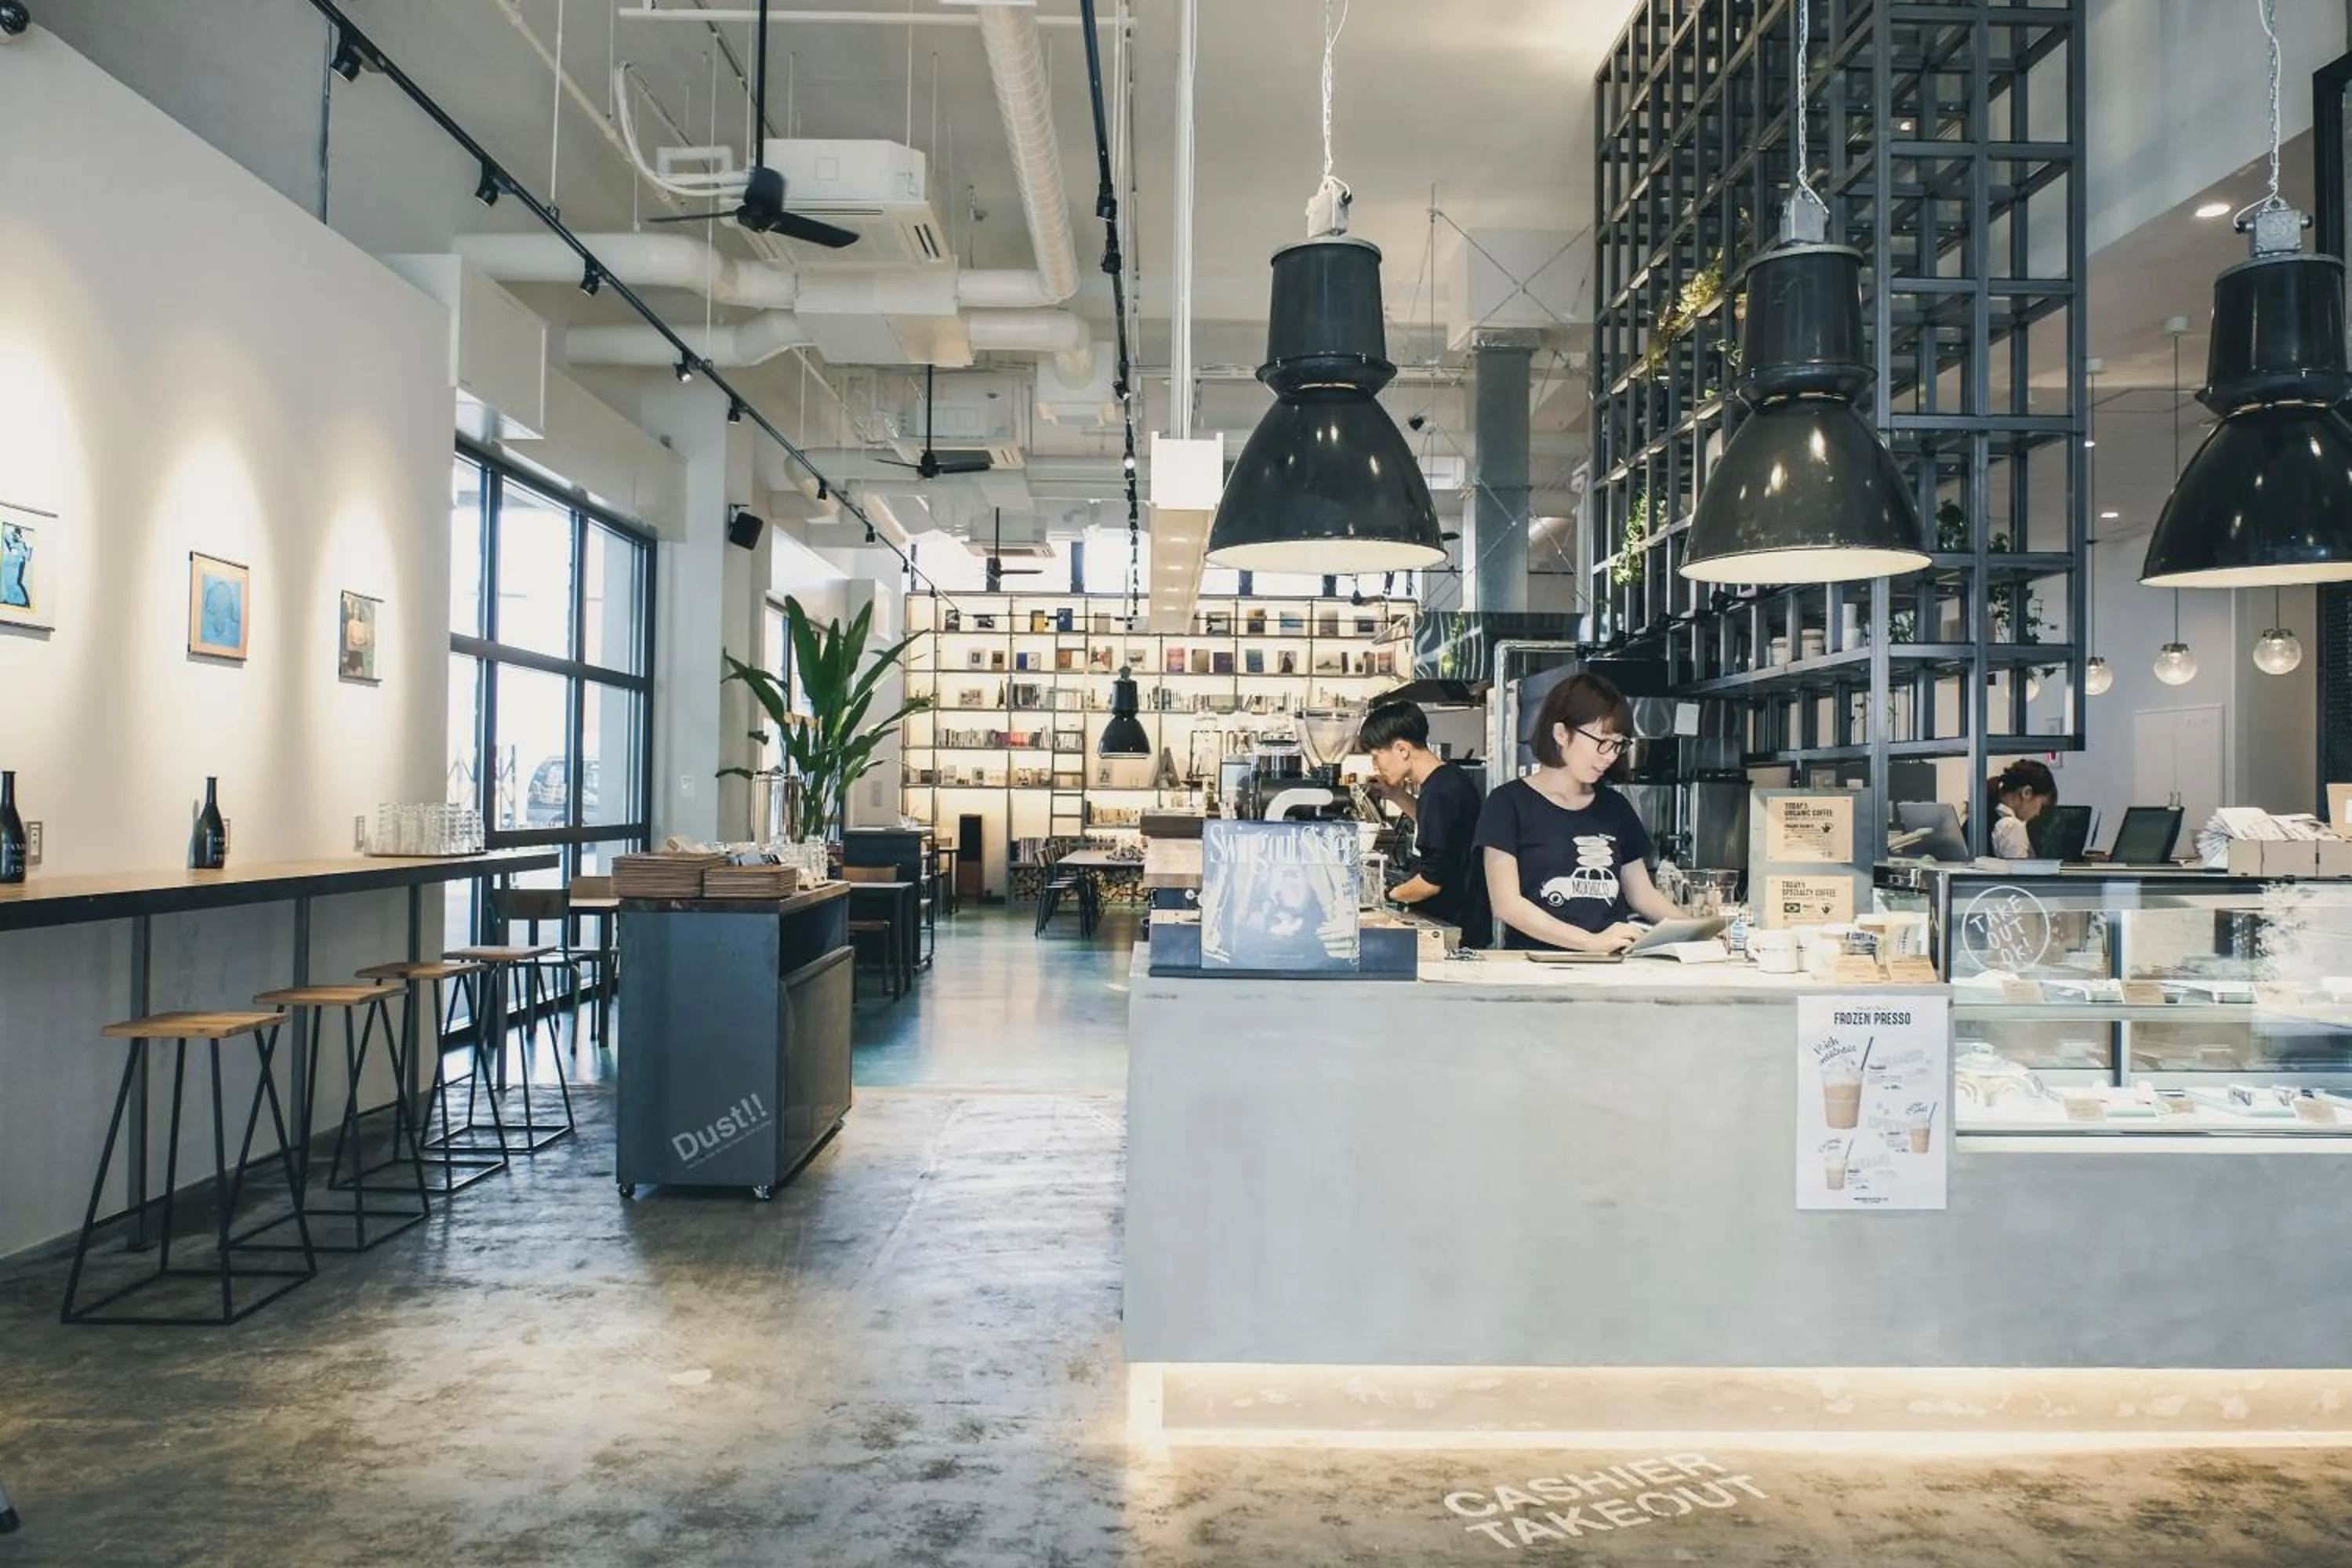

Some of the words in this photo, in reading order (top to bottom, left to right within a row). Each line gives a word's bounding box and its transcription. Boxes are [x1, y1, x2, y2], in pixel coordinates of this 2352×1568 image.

[1815, 889, 1837, 898] COFFEE
[1969, 895, 2024, 933] TAKE
[1987, 916, 2025, 949] OUT
[2001, 936, 2034, 965] OK!
[1834, 1012, 1871, 1025] FROZEN
[1874, 1012, 1911, 1025] PRESSO
[672, 1093, 768, 1160] Dust!!
[1443, 1452, 1726, 1517] CASHIER
[1465, 1475, 1769, 1549] TAKEOUT
